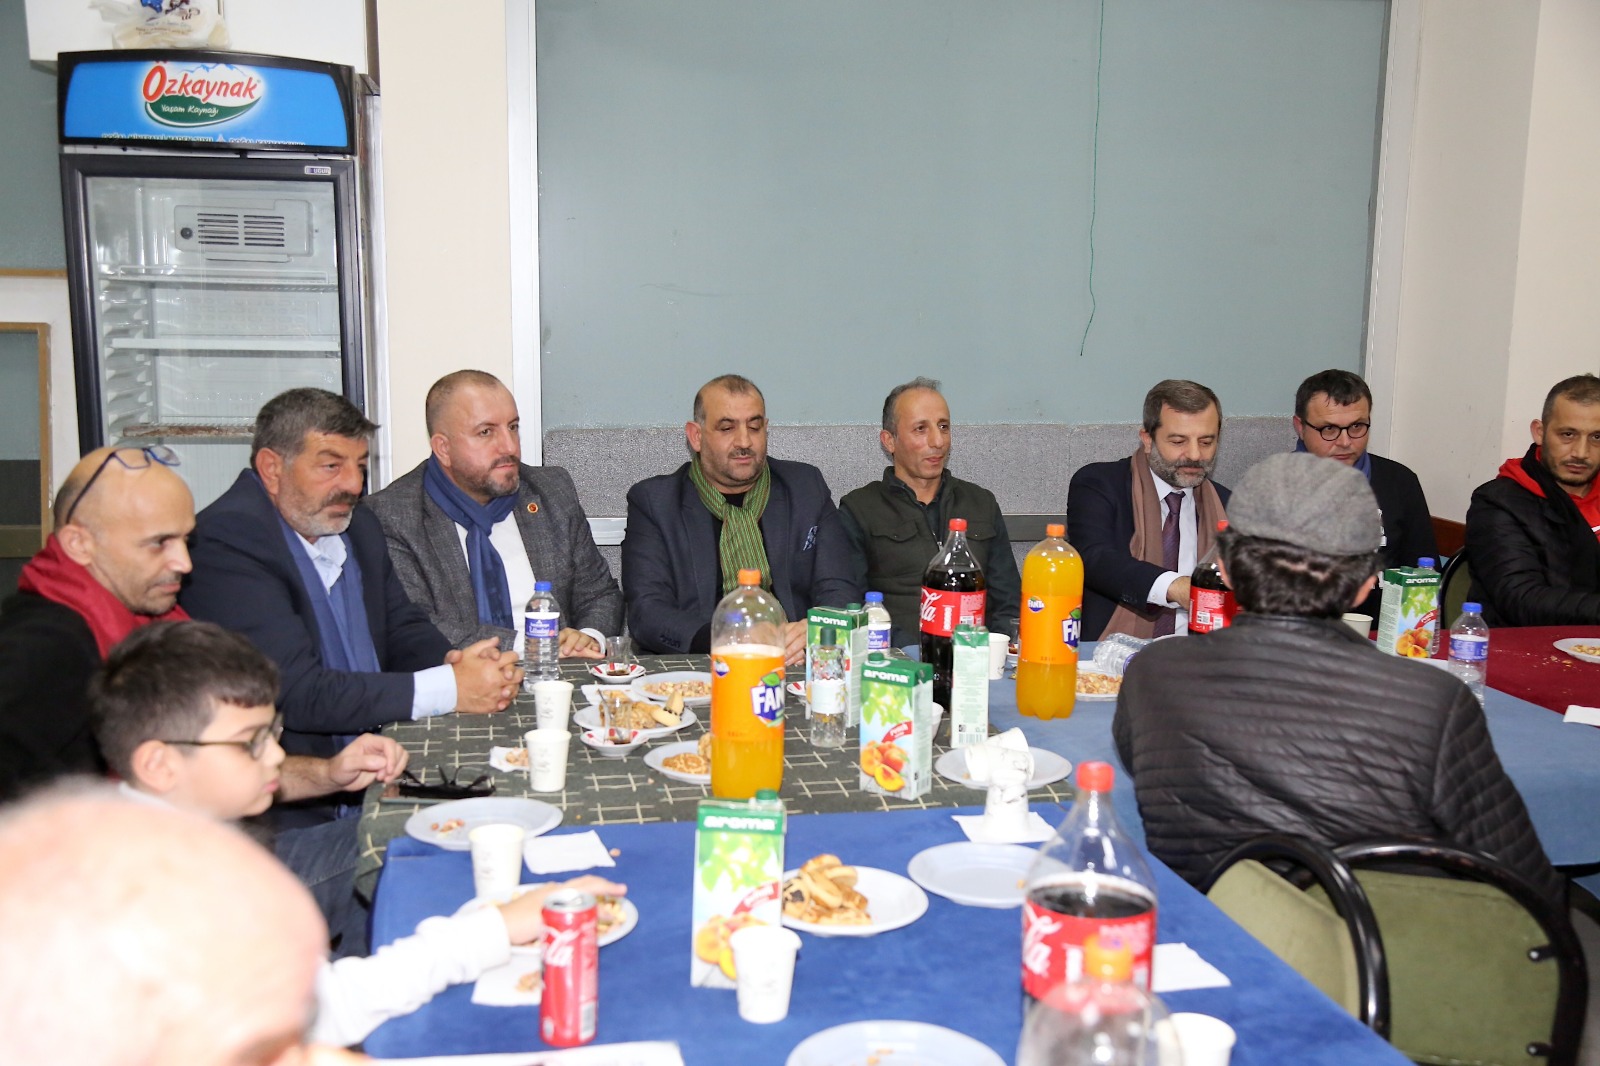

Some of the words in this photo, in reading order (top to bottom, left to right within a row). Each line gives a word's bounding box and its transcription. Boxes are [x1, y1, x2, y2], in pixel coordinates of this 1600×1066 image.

[143, 60, 257, 102] Özkaynak
[161, 104, 185, 113] Yaşam
[188, 105, 219, 117] Kaynağı
[810, 615, 848, 626] aroma
[863, 669, 909, 684] aroma
[703, 815, 776, 831] aroma
